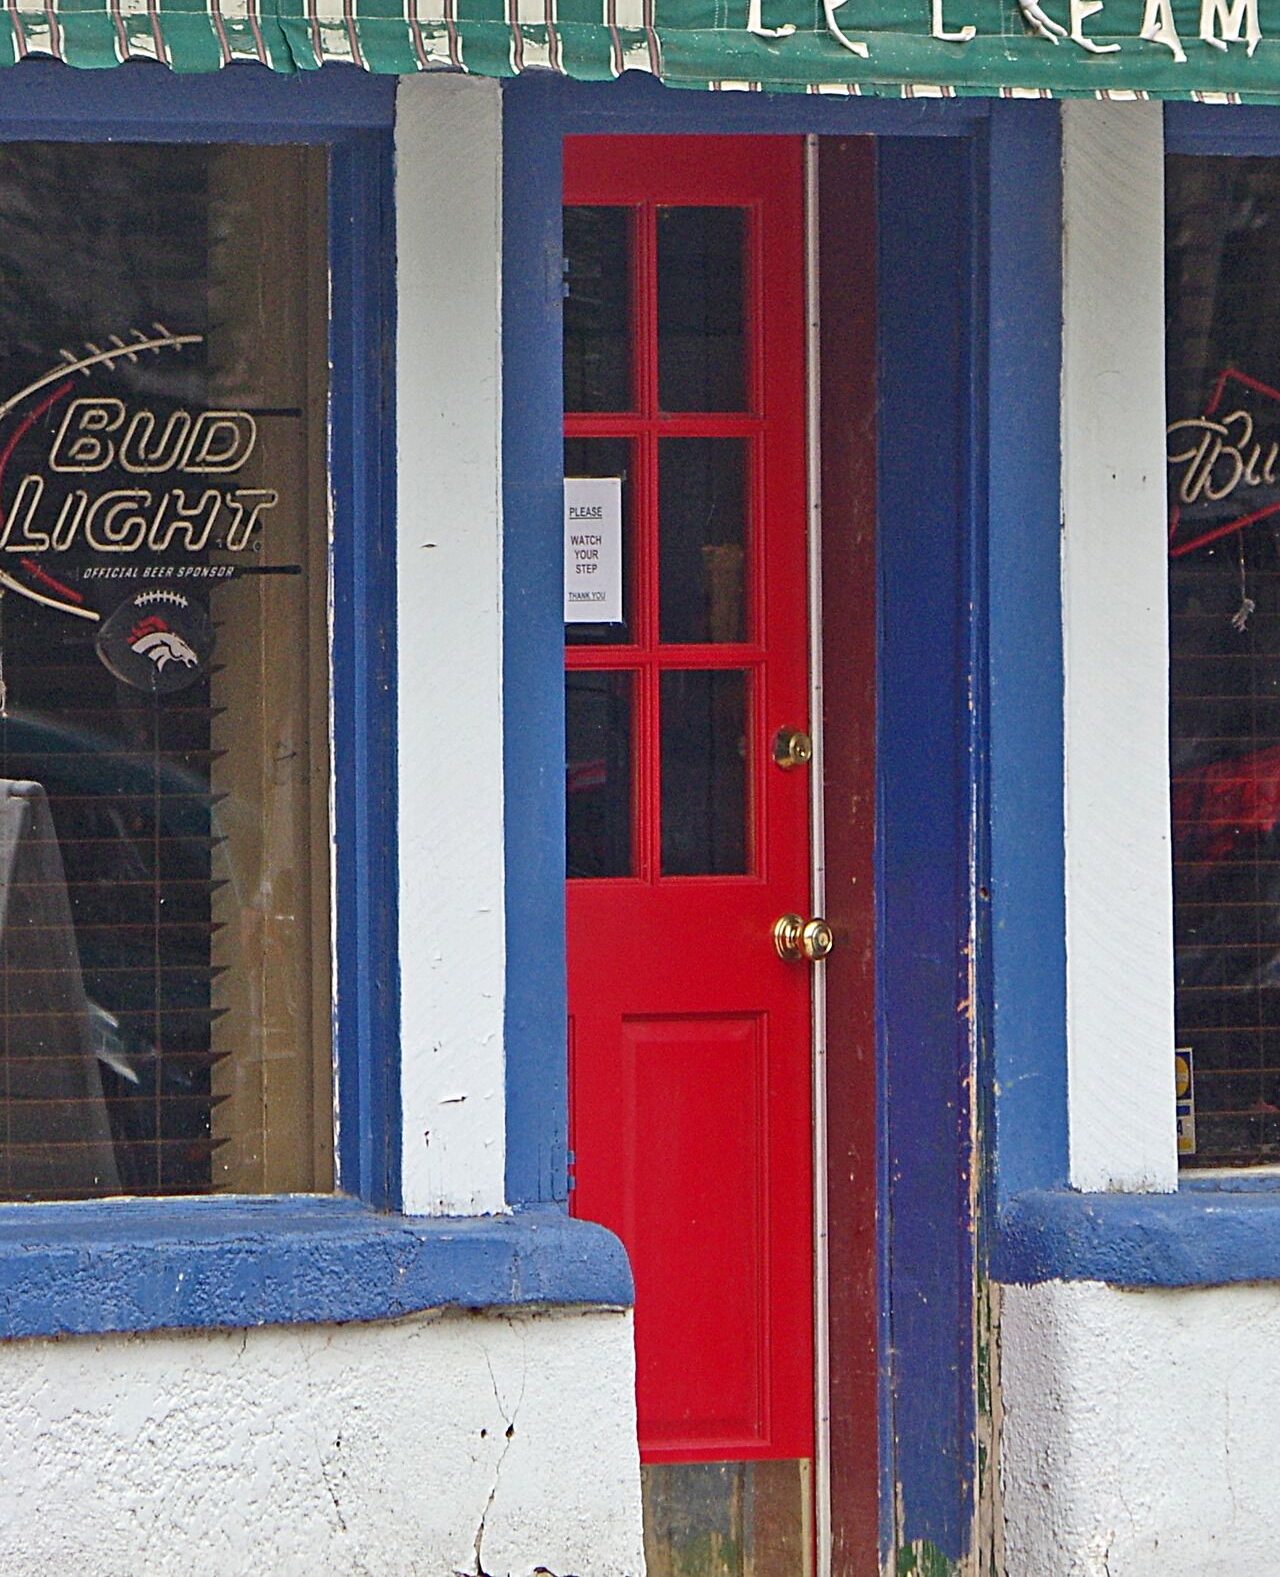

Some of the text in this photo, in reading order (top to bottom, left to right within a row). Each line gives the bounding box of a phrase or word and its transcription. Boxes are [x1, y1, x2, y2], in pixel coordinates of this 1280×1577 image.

[49, 397, 256, 473] BUD
[569, 506, 602, 519] PLEASE
[570, 535, 602, 546] WATCH
[574, 550, 599, 560] YOUR
[83, 566, 235, 579] OFFICIAL BEER SPONSOR
[575, 564, 598, 574] STEP
[568, 592, 606, 600] THANK YOU
